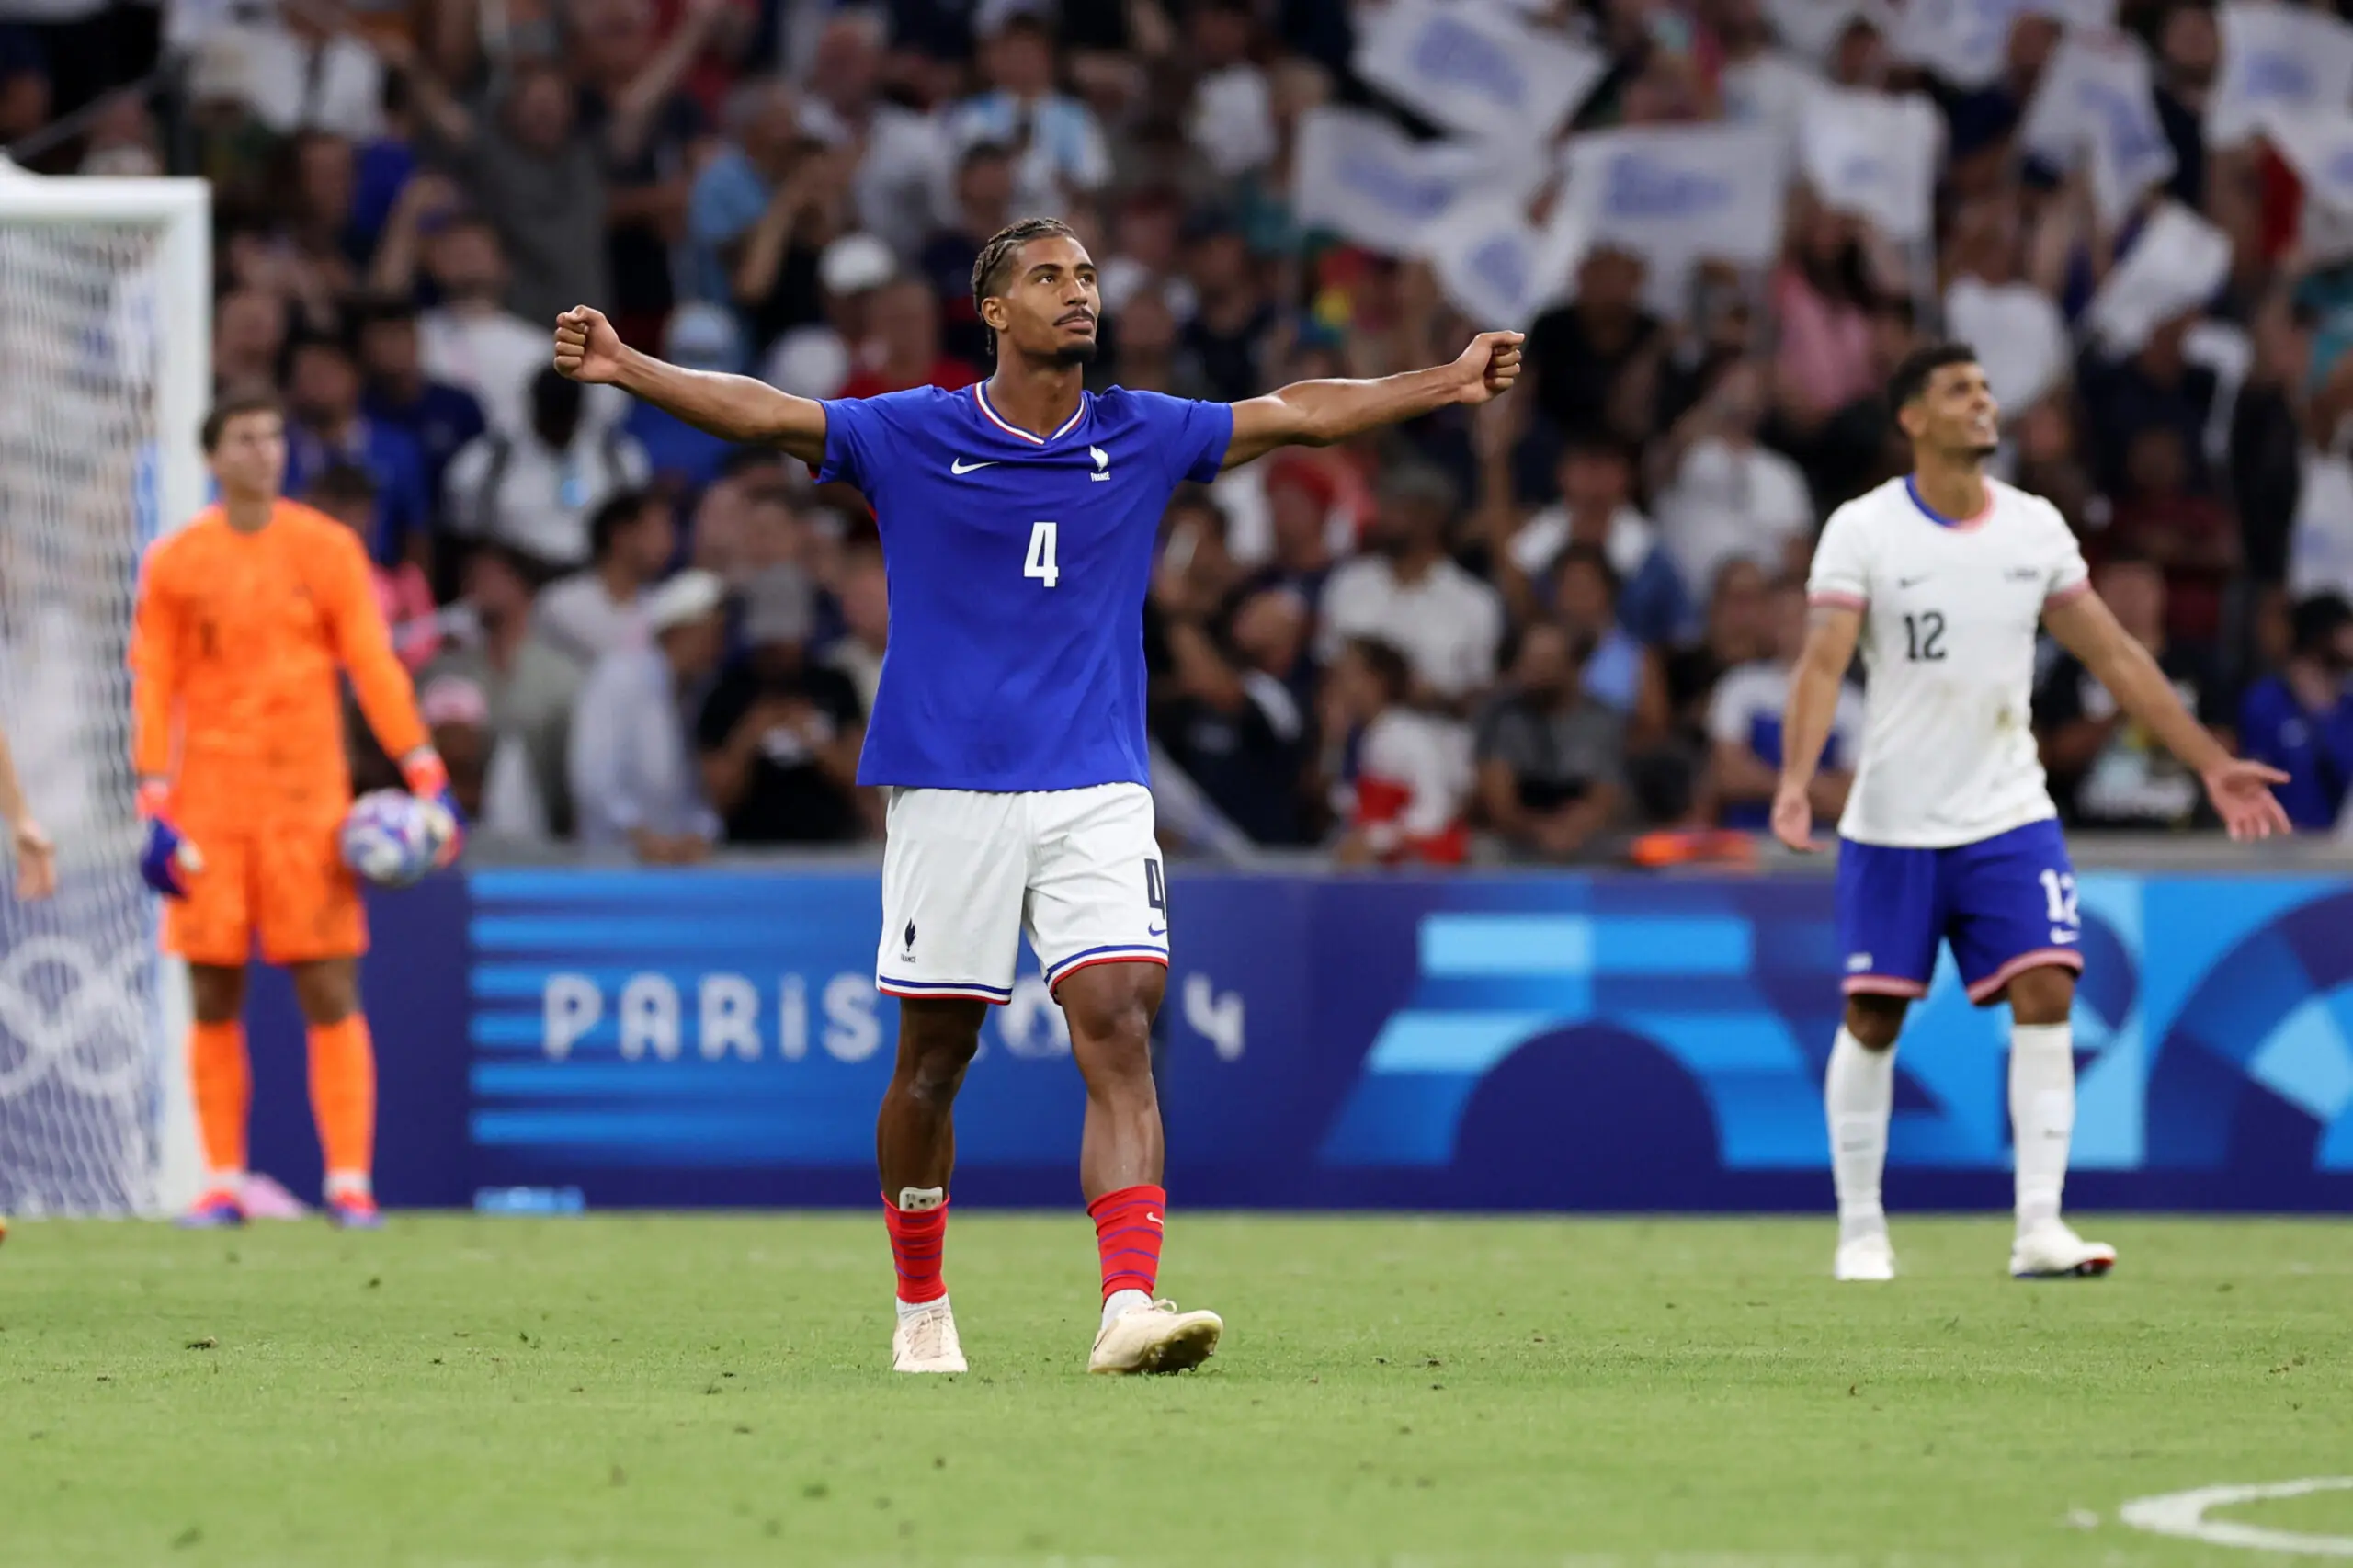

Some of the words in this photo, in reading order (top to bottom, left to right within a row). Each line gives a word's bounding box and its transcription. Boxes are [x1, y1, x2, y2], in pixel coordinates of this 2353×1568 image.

[1024, 521, 1059, 588] 4
[1904, 610, 1948, 663] 12
[1143, 858, 1166, 921] 4
[2039, 868, 2082, 929] 12
